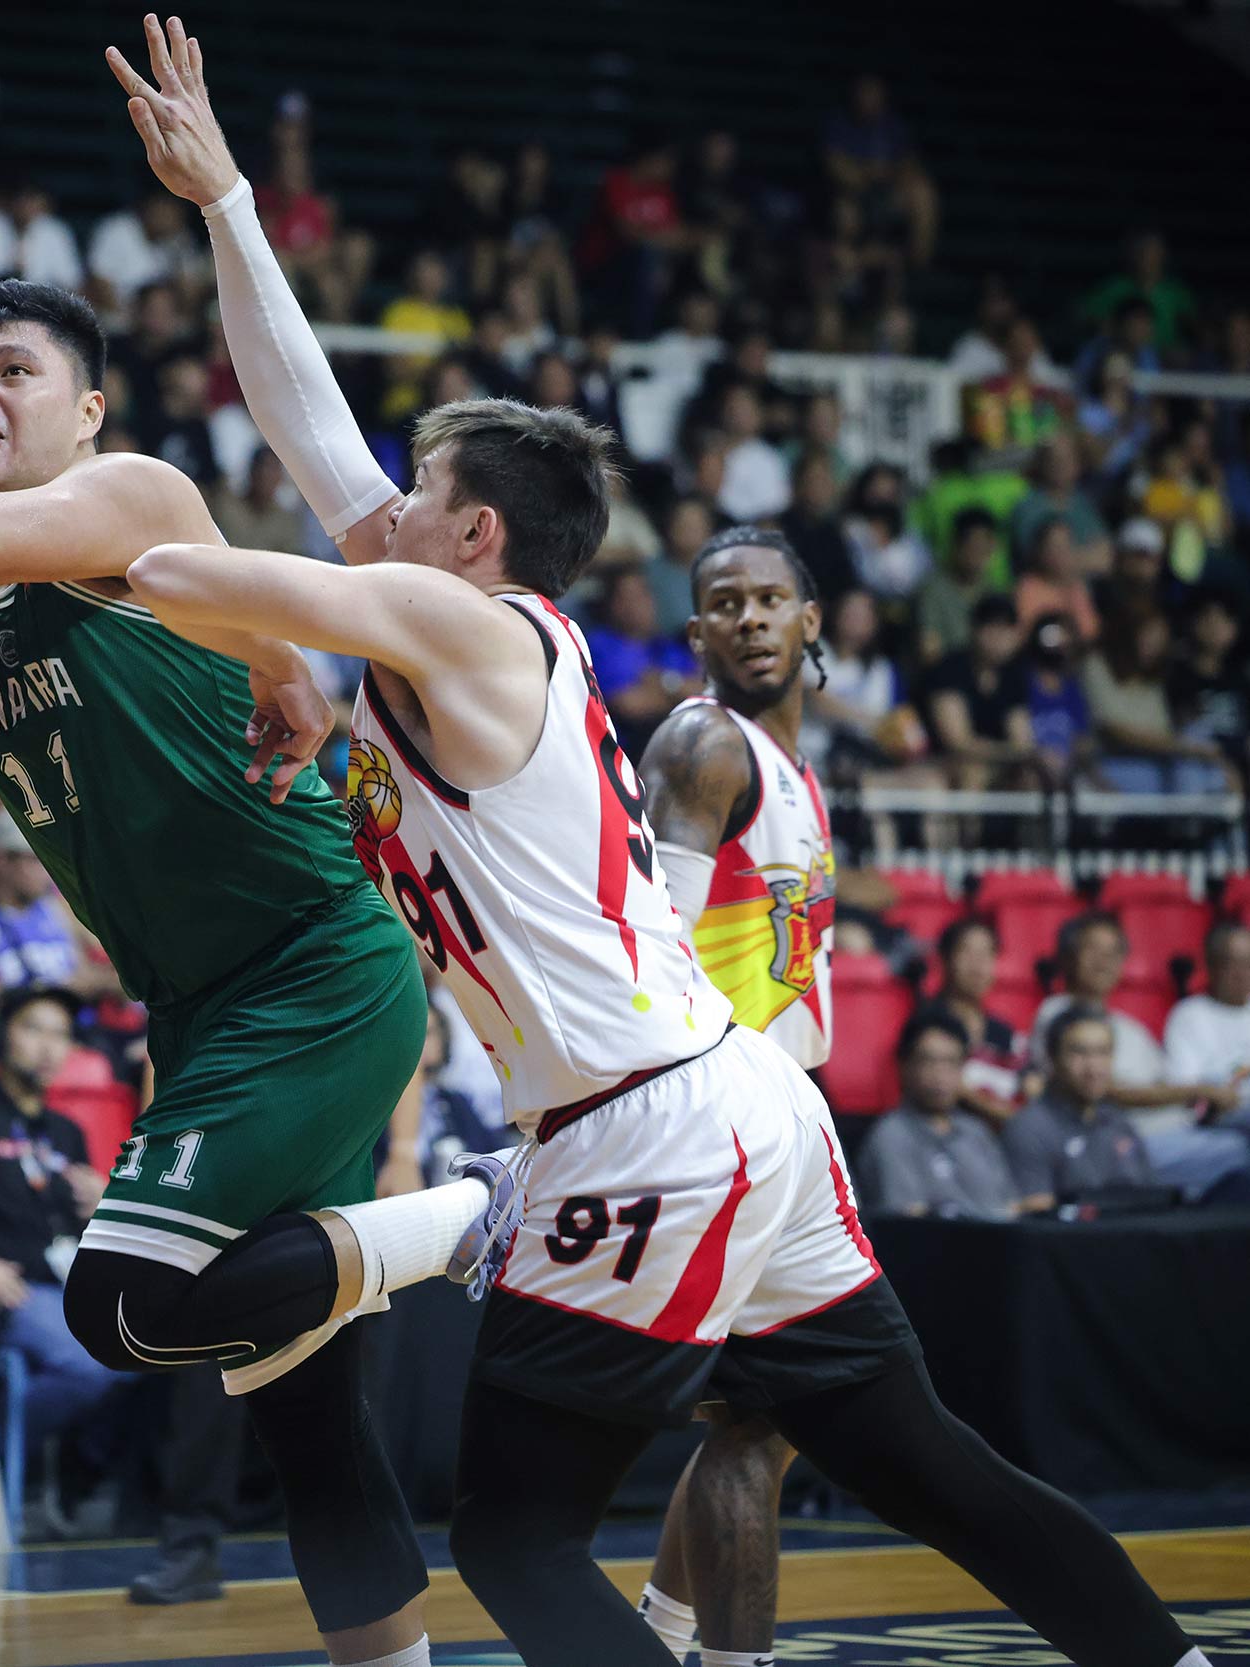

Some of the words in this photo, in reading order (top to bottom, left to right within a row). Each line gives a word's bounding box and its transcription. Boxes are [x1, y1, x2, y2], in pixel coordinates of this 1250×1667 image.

[0, 729, 82, 829] 11
[391, 849, 488, 974] 91
[115, 1128, 205, 1191] 11
[544, 1194, 662, 1284] 91
